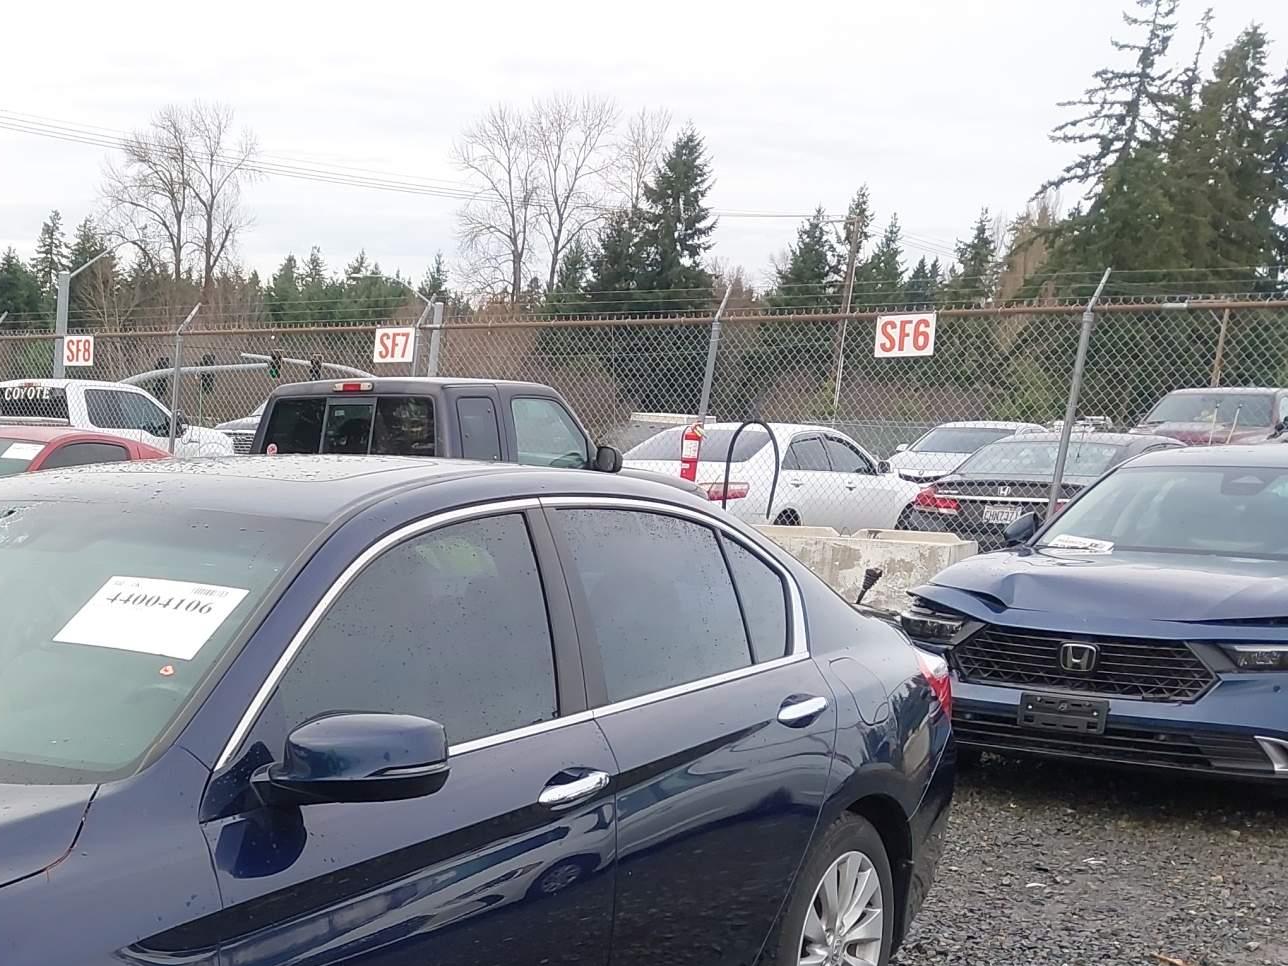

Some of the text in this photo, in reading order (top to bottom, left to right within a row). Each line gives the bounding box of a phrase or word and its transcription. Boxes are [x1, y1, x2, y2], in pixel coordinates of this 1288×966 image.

[378, 332, 411, 360] SF7
[879, 318, 931, 353] SF6
[66, 338, 91, 363] SF8
[4, 386, 51, 401] COYOTE
[106, 591, 214, 615] 44004106
